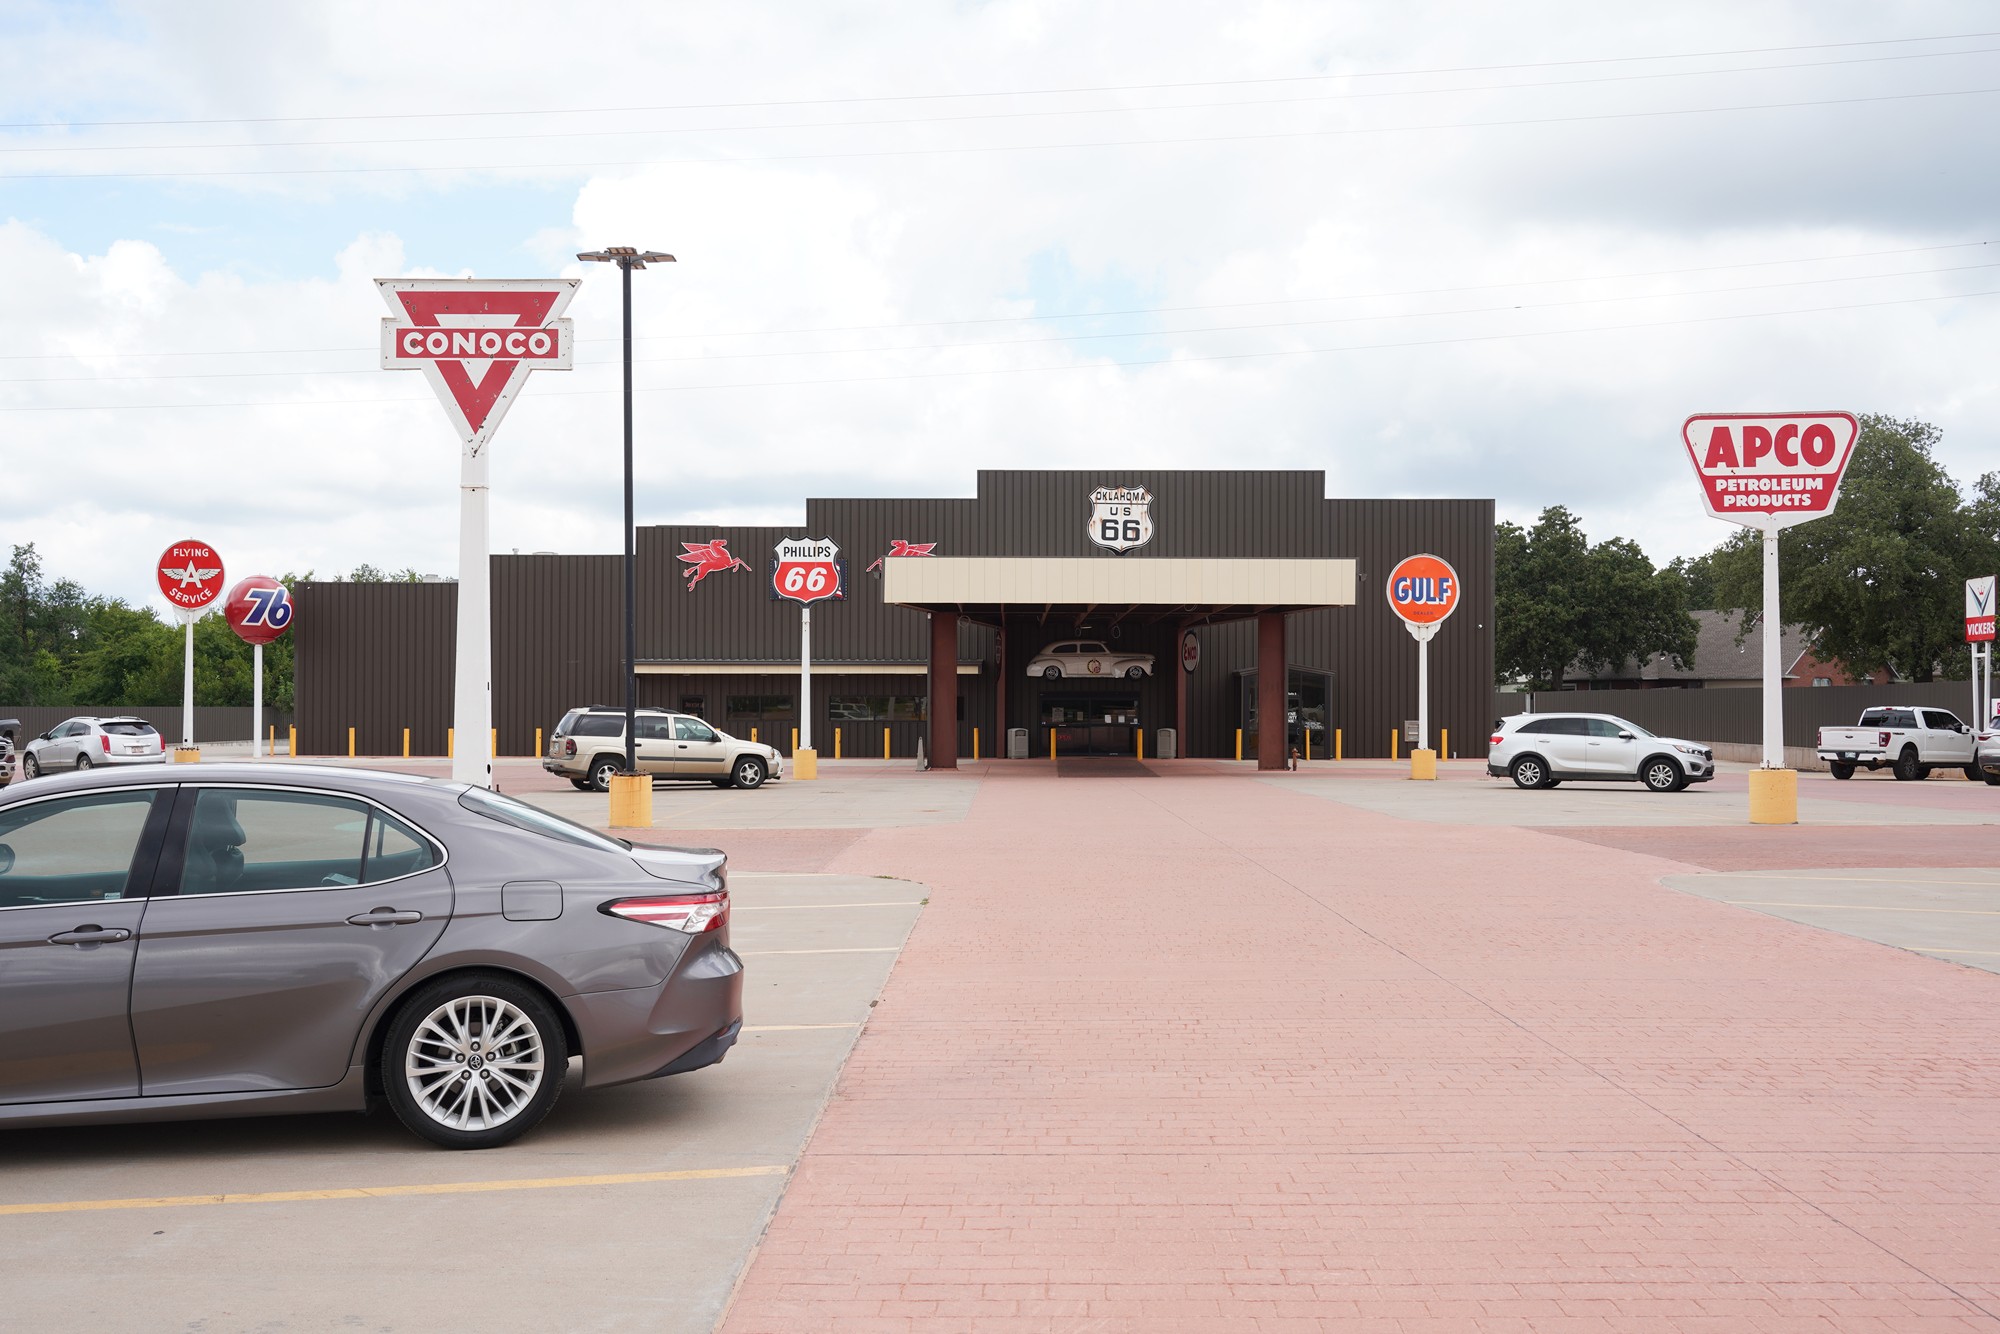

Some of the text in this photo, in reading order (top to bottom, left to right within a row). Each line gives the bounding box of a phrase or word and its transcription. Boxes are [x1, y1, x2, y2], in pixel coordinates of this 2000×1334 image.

[403, 331, 552, 355] CONOCO
[1703, 423, 1836, 468] APCO
[1715, 478, 1823, 492] PETROLEUM
[1096, 491, 1146, 501] OKLAHOMA
[1723, 493, 1812, 507] PRODUCTS
[1101, 519, 1141, 542] 66
[173, 548, 209, 557] FLYING
[783, 546, 831, 558] PHILLIPS
[784, 566, 827, 592] 66
[169, 587, 213, 604] SERVICE
[1394, 577, 1452, 605] GULF
[240, 587, 293, 629] 76
[1967, 621, 1996, 637] VICKERS
